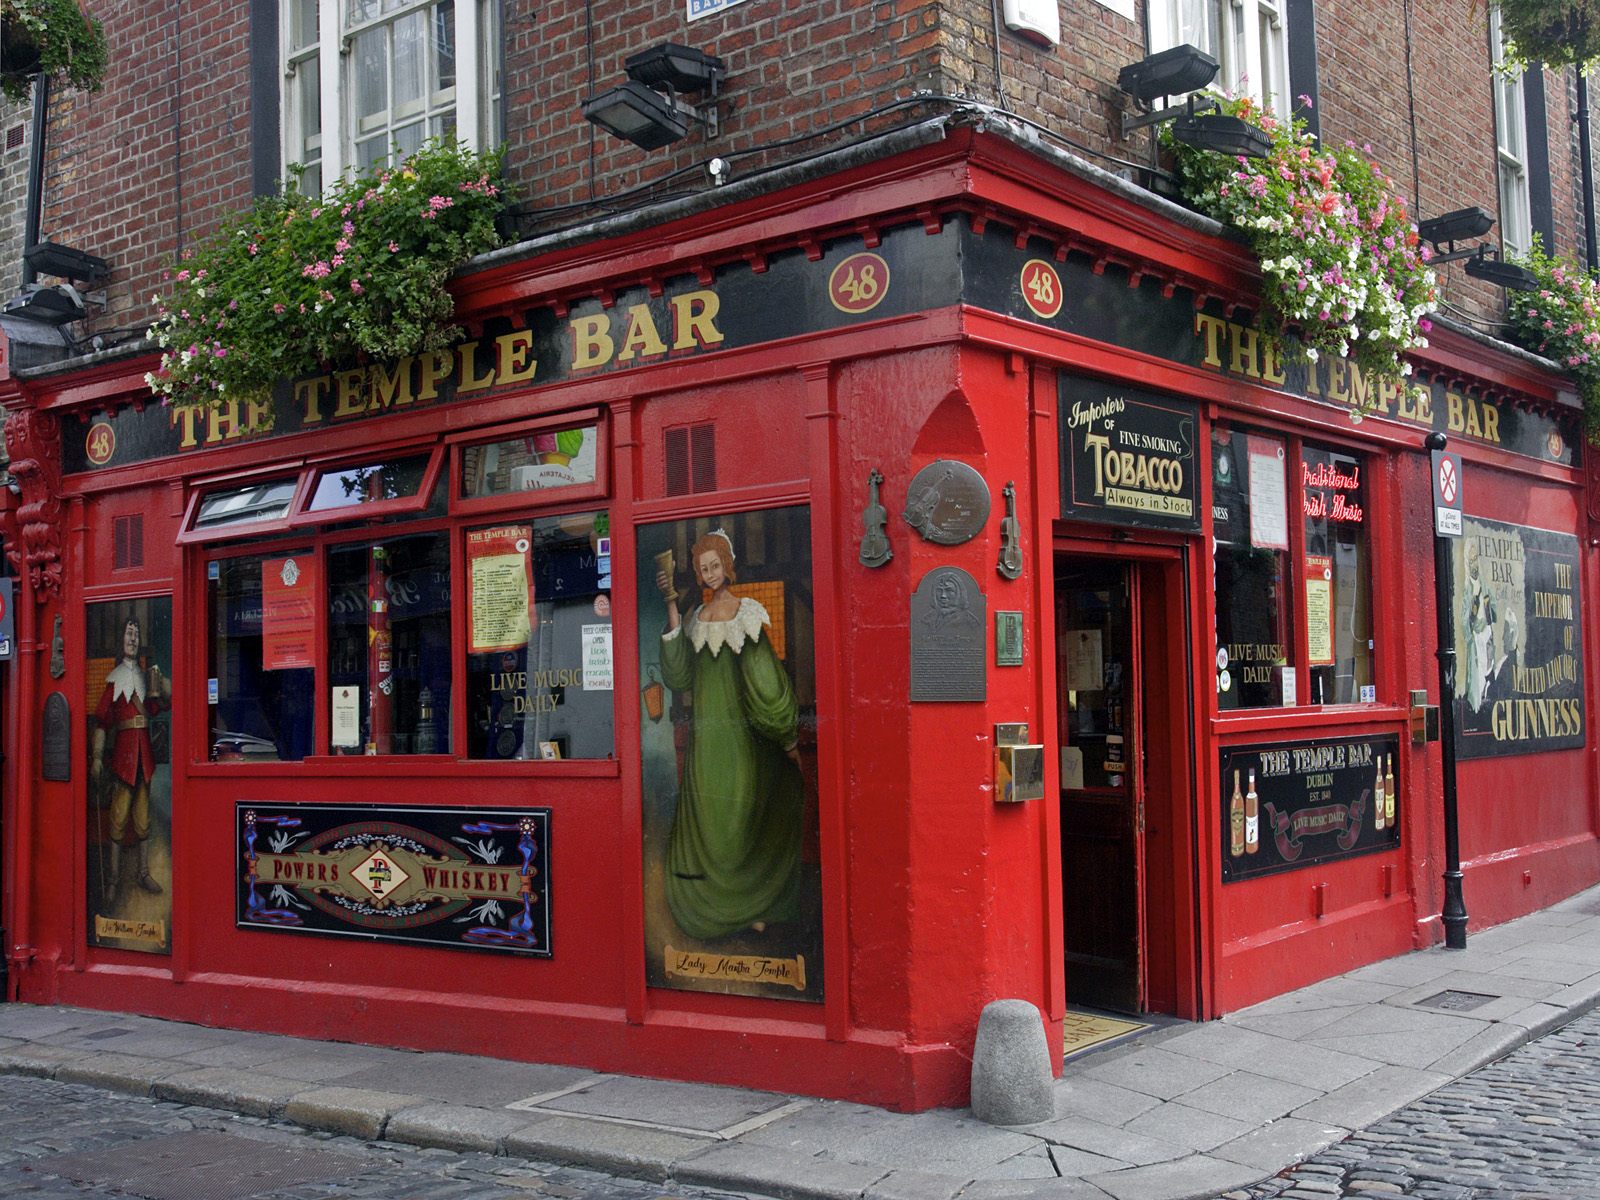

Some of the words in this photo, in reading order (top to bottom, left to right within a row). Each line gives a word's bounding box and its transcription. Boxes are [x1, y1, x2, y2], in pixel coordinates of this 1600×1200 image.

[838, 264, 878, 303] 48
[1028, 267, 1054, 305] 48
[172, 399, 275, 451] THE
[294, 330, 537, 425] TEMPLE
[569, 289, 725, 371] BAR
[1196, 313, 1285, 384] THE
[1306, 353, 1434, 424] TEMPLE
[1446, 391, 1500, 442] BAR
[1067, 397, 1125, 433] Importers
[1104, 419, 1115, 430] OF
[90, 431, 109, 458] 48
[1119, 431, 1140, 447] FINE
[1142, 435, 1181, 454] SMOKING
[1084, 433, 1183, 497] TOBACCO
[1107, 489, 1145, 507] Always
[1150, 500, 1159, 508] in
[1163, 496, 1191, 513] Stock
[1330, 494, 1362, 522] Music
[470, 533, 482, 541] THE
[484, 529, 508, 540] TEMPLE
[511, 528, 527, 537] BAR
[1476, 536, 1523, 561] TEMPLE
[1491, 561, 1514, 586] BAR
[1554, 563, 1572, 589] THE
[1534, 592, 1573, 620] EMPEROR
[1563, 625, 1573, 651] OF
[1228, 644, 1252, 660] LIVE
[1255, 644, 1286, 660] MUSIC
[490, 672, 527, 691] LIVE
[534, 668, 583, 688] MUSIC
[1243, 666, 1272, 683] DAILY
[1512, 664, 1546, 694] MALTED
[1546, 654, 1577, 689] LIQUORS
[513, 694, 560, 714] DAILY
[1492, 698, 1581, 741] GUINNESS
[1259, 750, 1290, 778] THE
[1293, 745, 1346, 774] TEMPLE
[1348, 743, 1373, 768] BAR
[1306, 773, 1334, 789] DUBLIN
[1309, 791, 1320, 802] EST.
[1293, 819, 1309, 831] LIVE
[1309, 815, 1327, 828] MUSIC
[1328, 812, 1346, 826] DAILY
[273, 859, 339, 882] POWERS
[423, 866, 510, 892] WHISKEY
[677, 955, 705, 973] Lady
[708, 958, 750, 976] Martha
[752, 960, 790, 978] Temple
